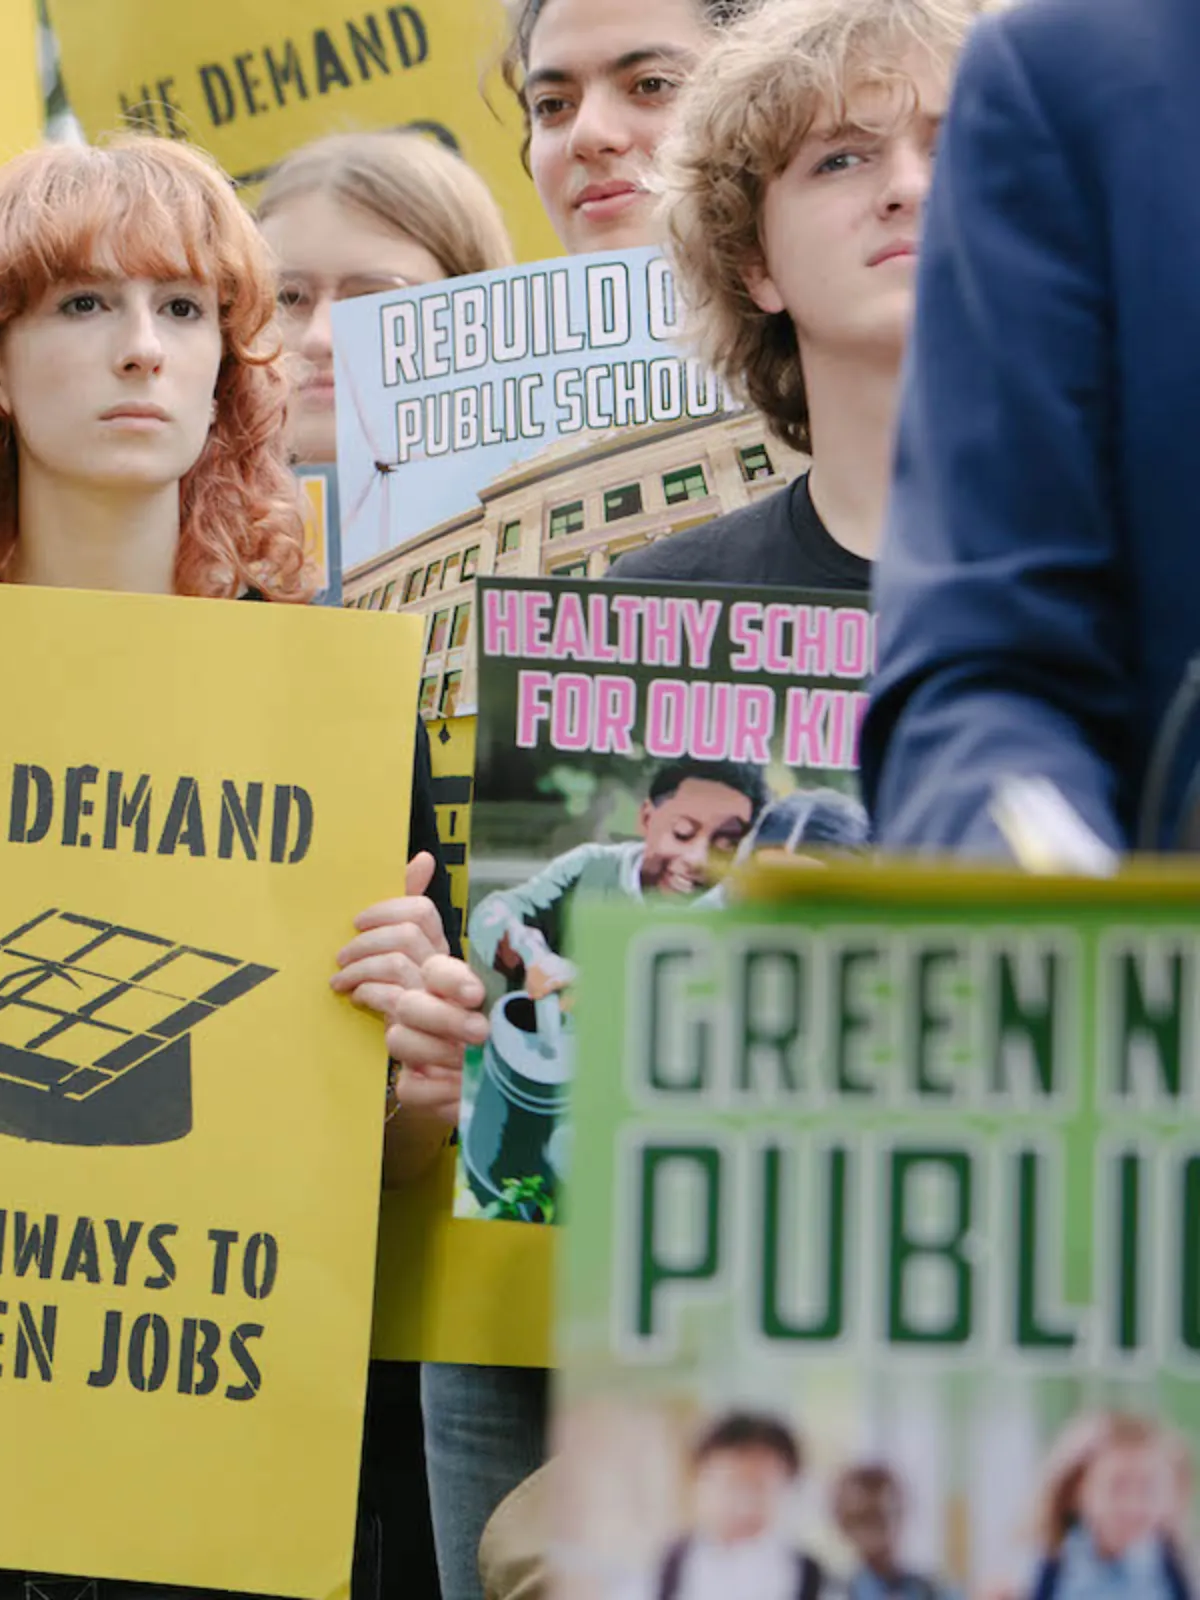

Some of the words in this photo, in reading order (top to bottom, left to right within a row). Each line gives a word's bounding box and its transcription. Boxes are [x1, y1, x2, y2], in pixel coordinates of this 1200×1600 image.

[199, 2, 430, 127] DEMAND
[380, 261, 630, 388] REBUILD
[395, 371, 545, 464] PUBLIC
[482, 588, 723, 670] HEALTHY
[729, 600, 879, 679] SCHO
[516, 669, 636, 757] FOR
[645, 677, 776, 765] OUR
[7, 761, 315, 865] DEMAND
[638, 936, 1068, 1101] GREEN
[207, 1227, 279, 1300] TO
[626, 1134, 1200, 1356] PUBLI
[86, 1309, 265, 1402] JOBS
